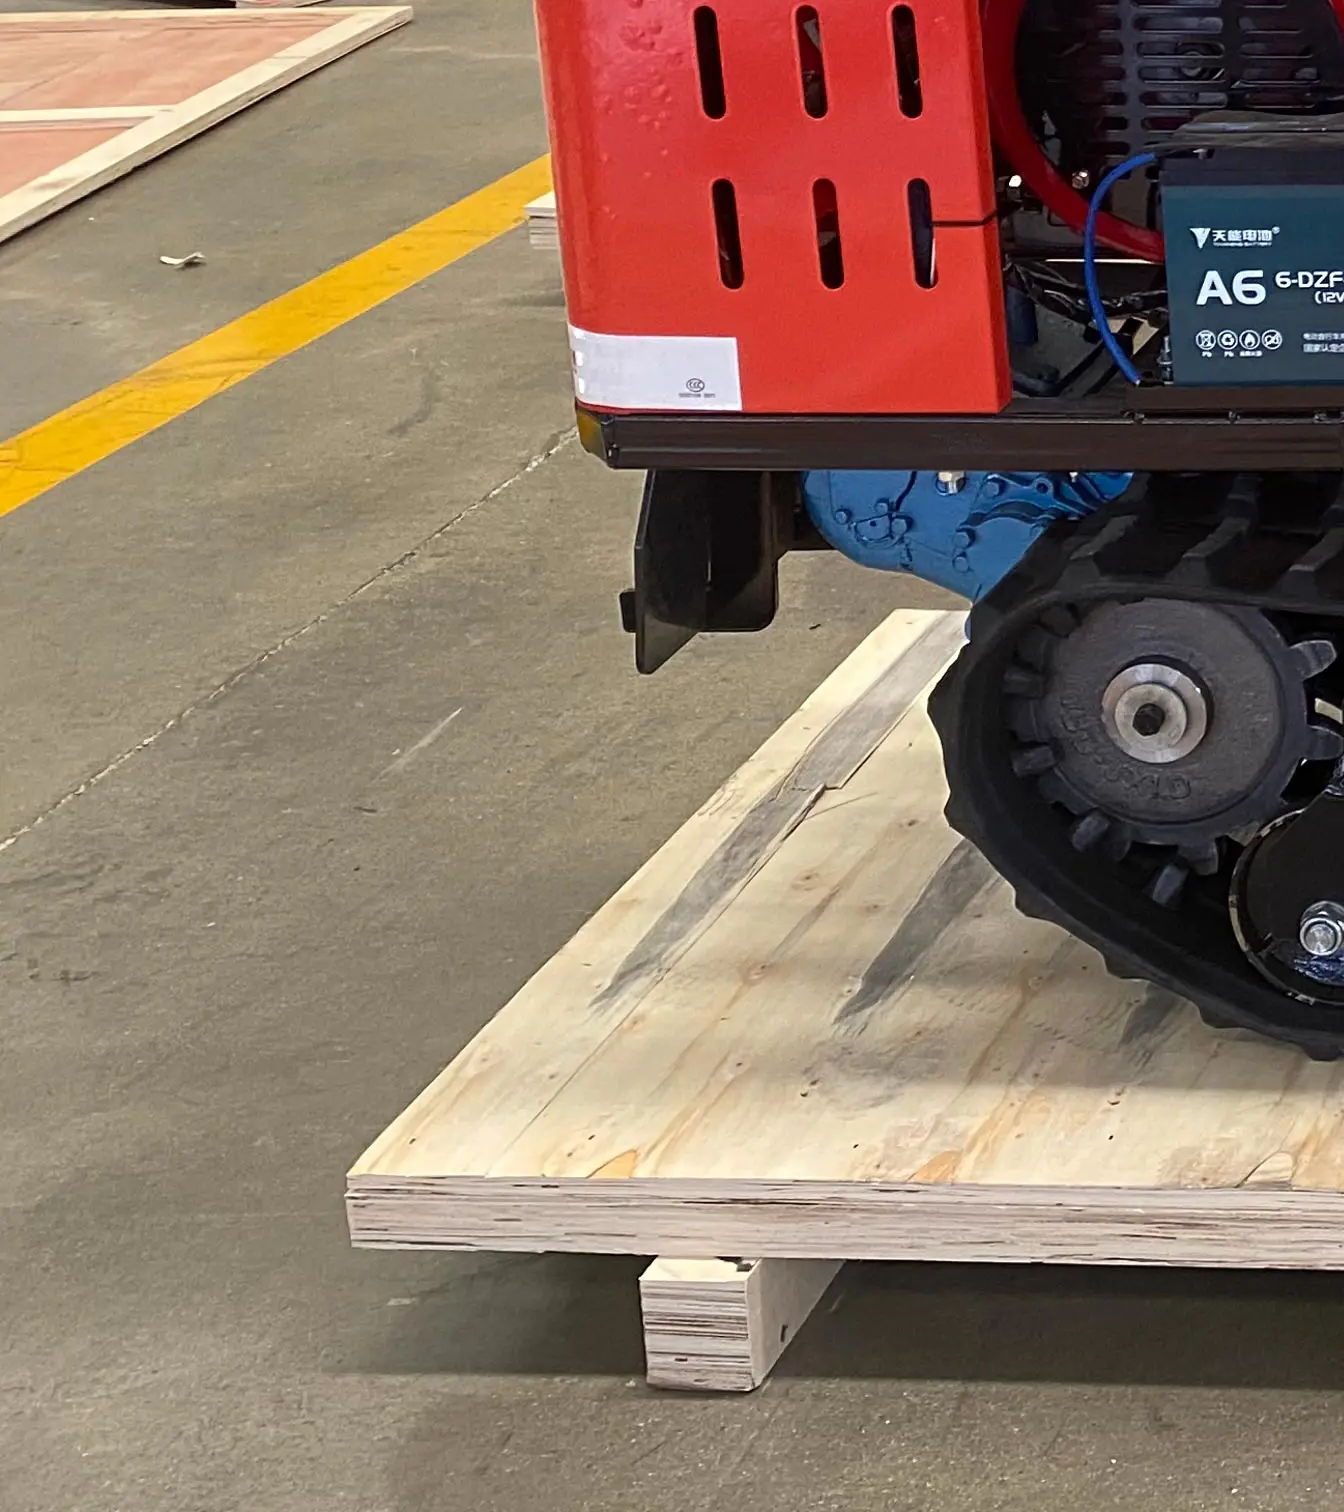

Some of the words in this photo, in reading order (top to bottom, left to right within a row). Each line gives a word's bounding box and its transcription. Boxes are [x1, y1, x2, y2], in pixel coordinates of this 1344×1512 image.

[1212, 229, 1272, 242] 天能电池
[1196, 270, 1267, 306] A6
